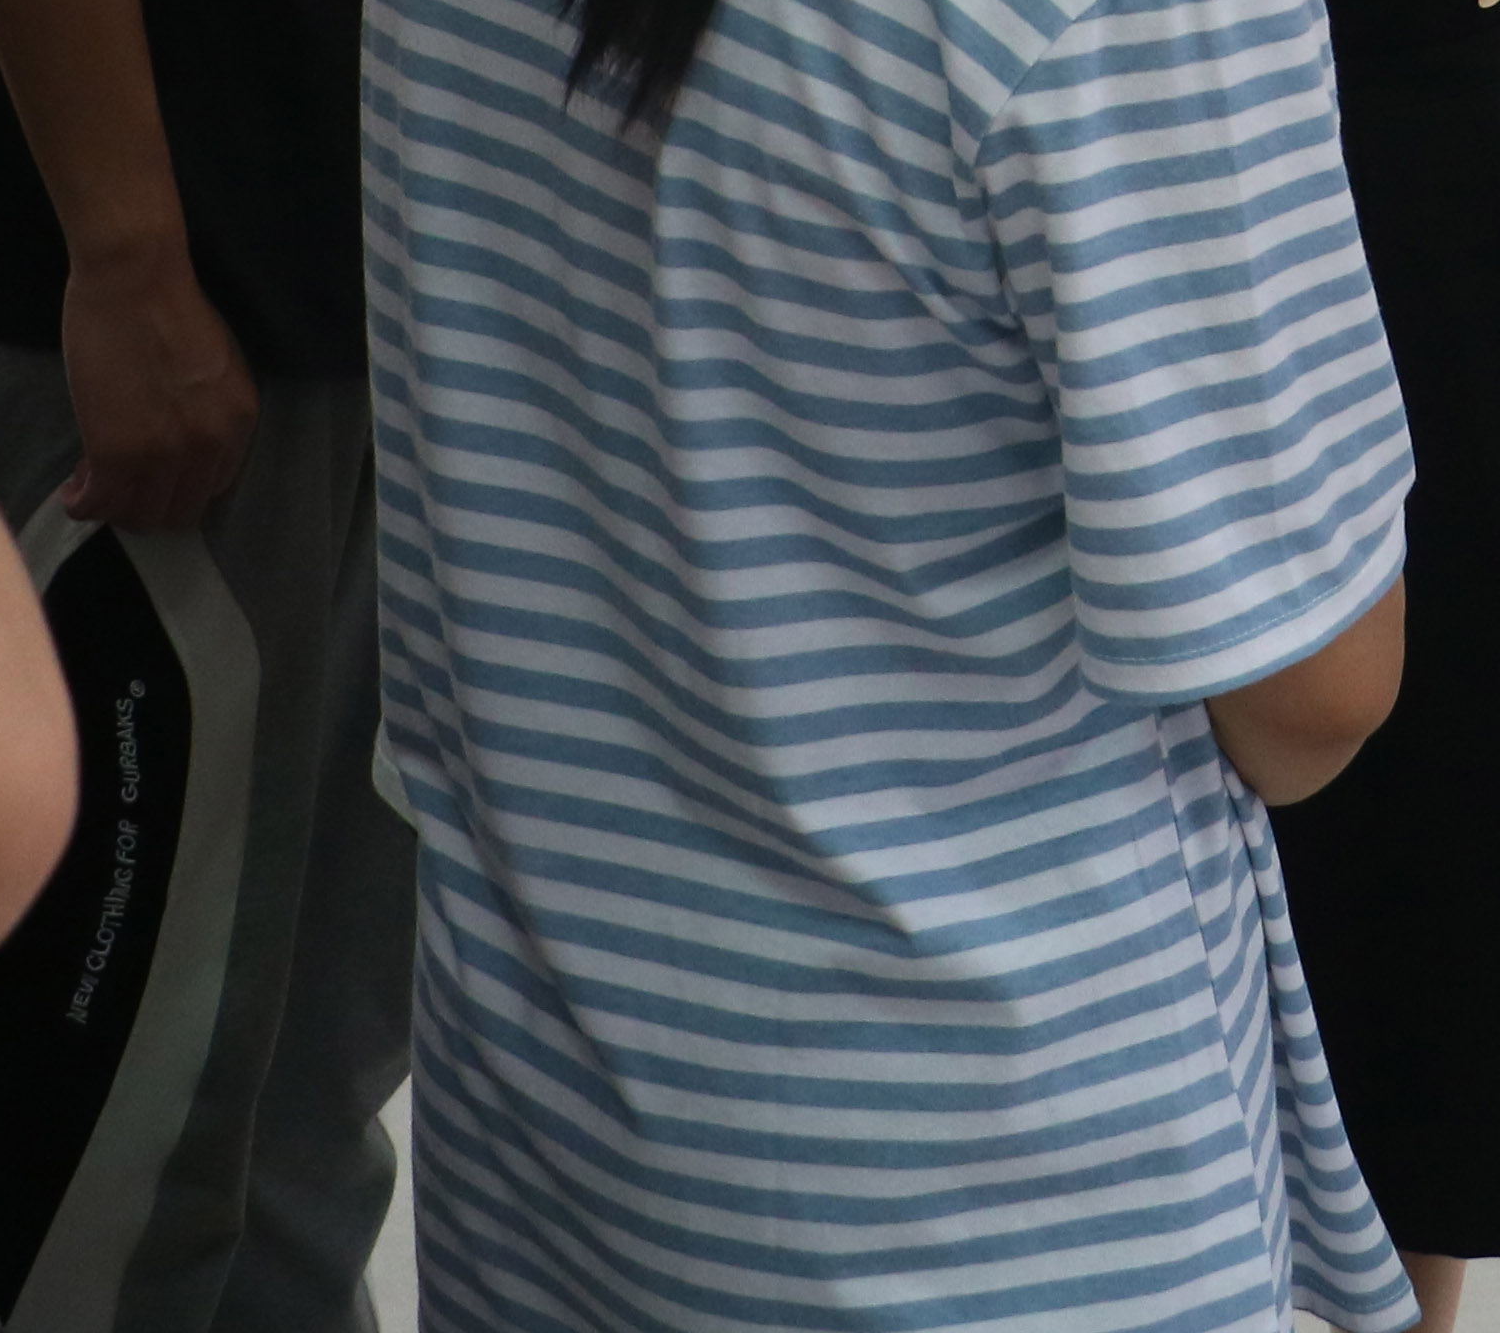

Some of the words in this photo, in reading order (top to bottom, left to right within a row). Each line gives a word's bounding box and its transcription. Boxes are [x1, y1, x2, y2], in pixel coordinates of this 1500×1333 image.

[65, 974, 100, 1025] NEW
[85, 867, 135, 972] CLOTHING
[114, 818, 139, 865] FOR
